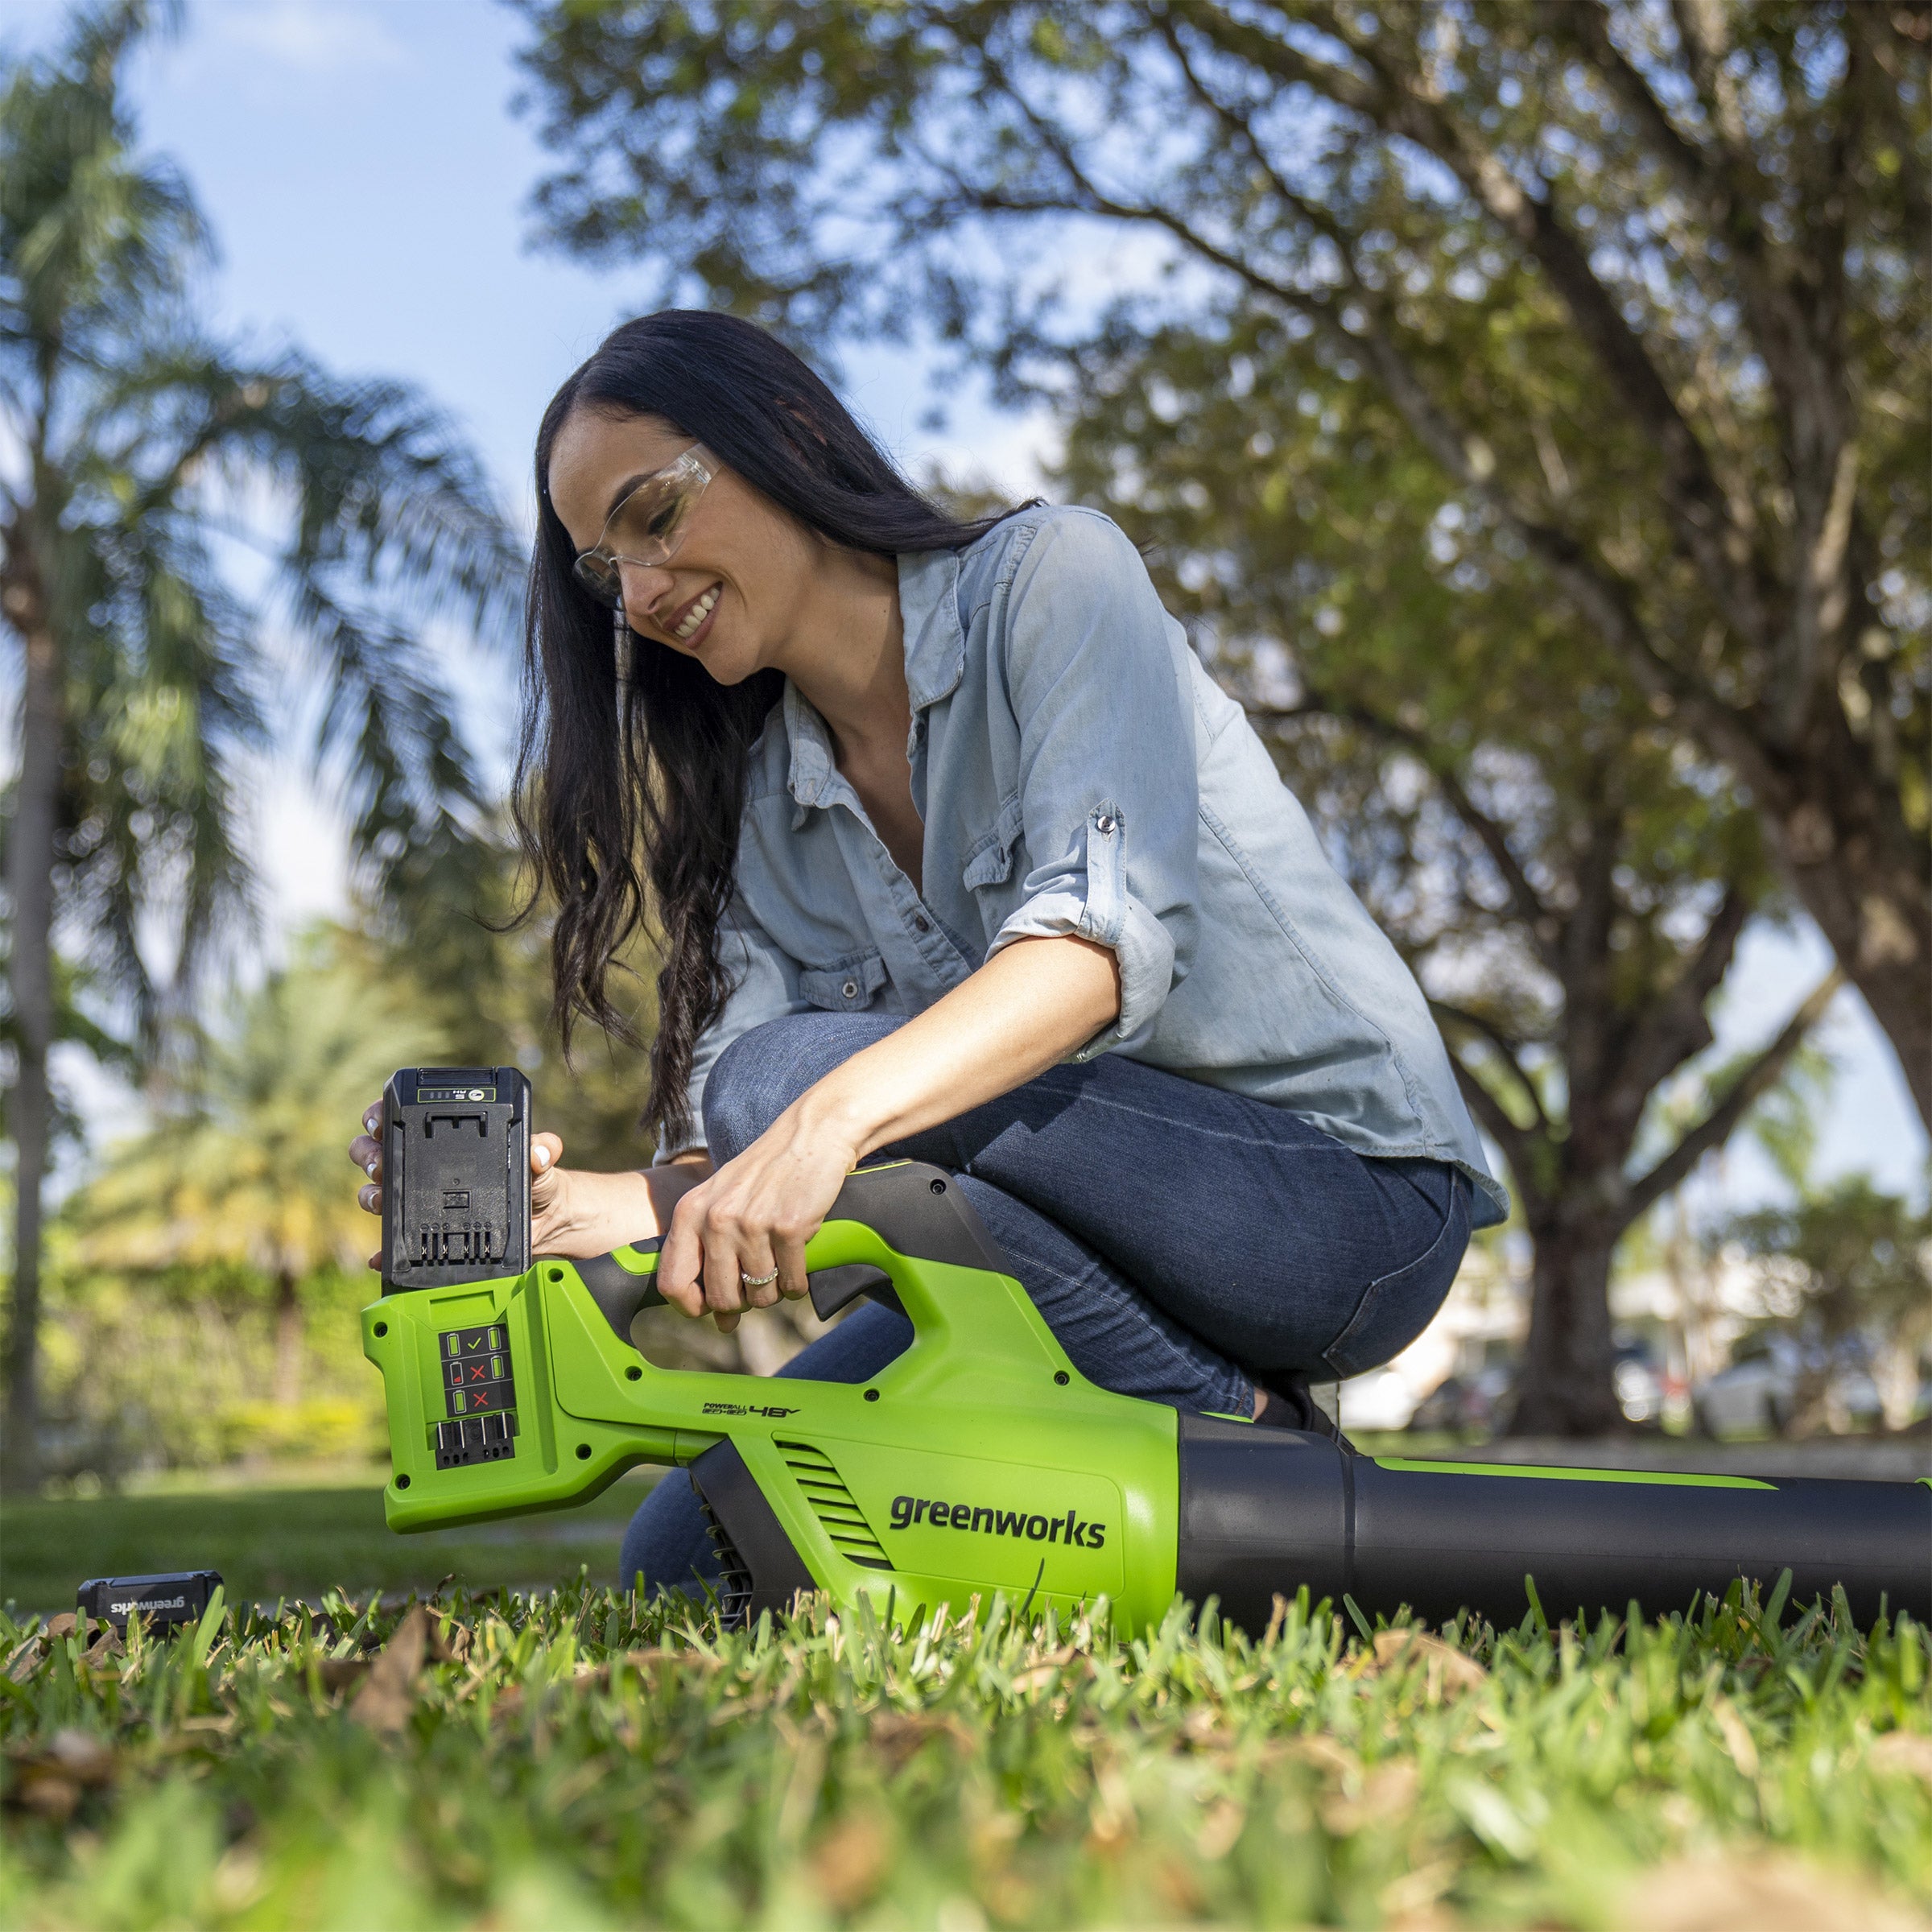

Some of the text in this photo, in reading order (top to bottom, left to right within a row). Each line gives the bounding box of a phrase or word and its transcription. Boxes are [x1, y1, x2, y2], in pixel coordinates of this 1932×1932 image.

[704, 1402, 747, 1410] POWERALL
[749, 1406, 802, 1418] 48V
[890, 1495, 1106, 1549] greenworks
